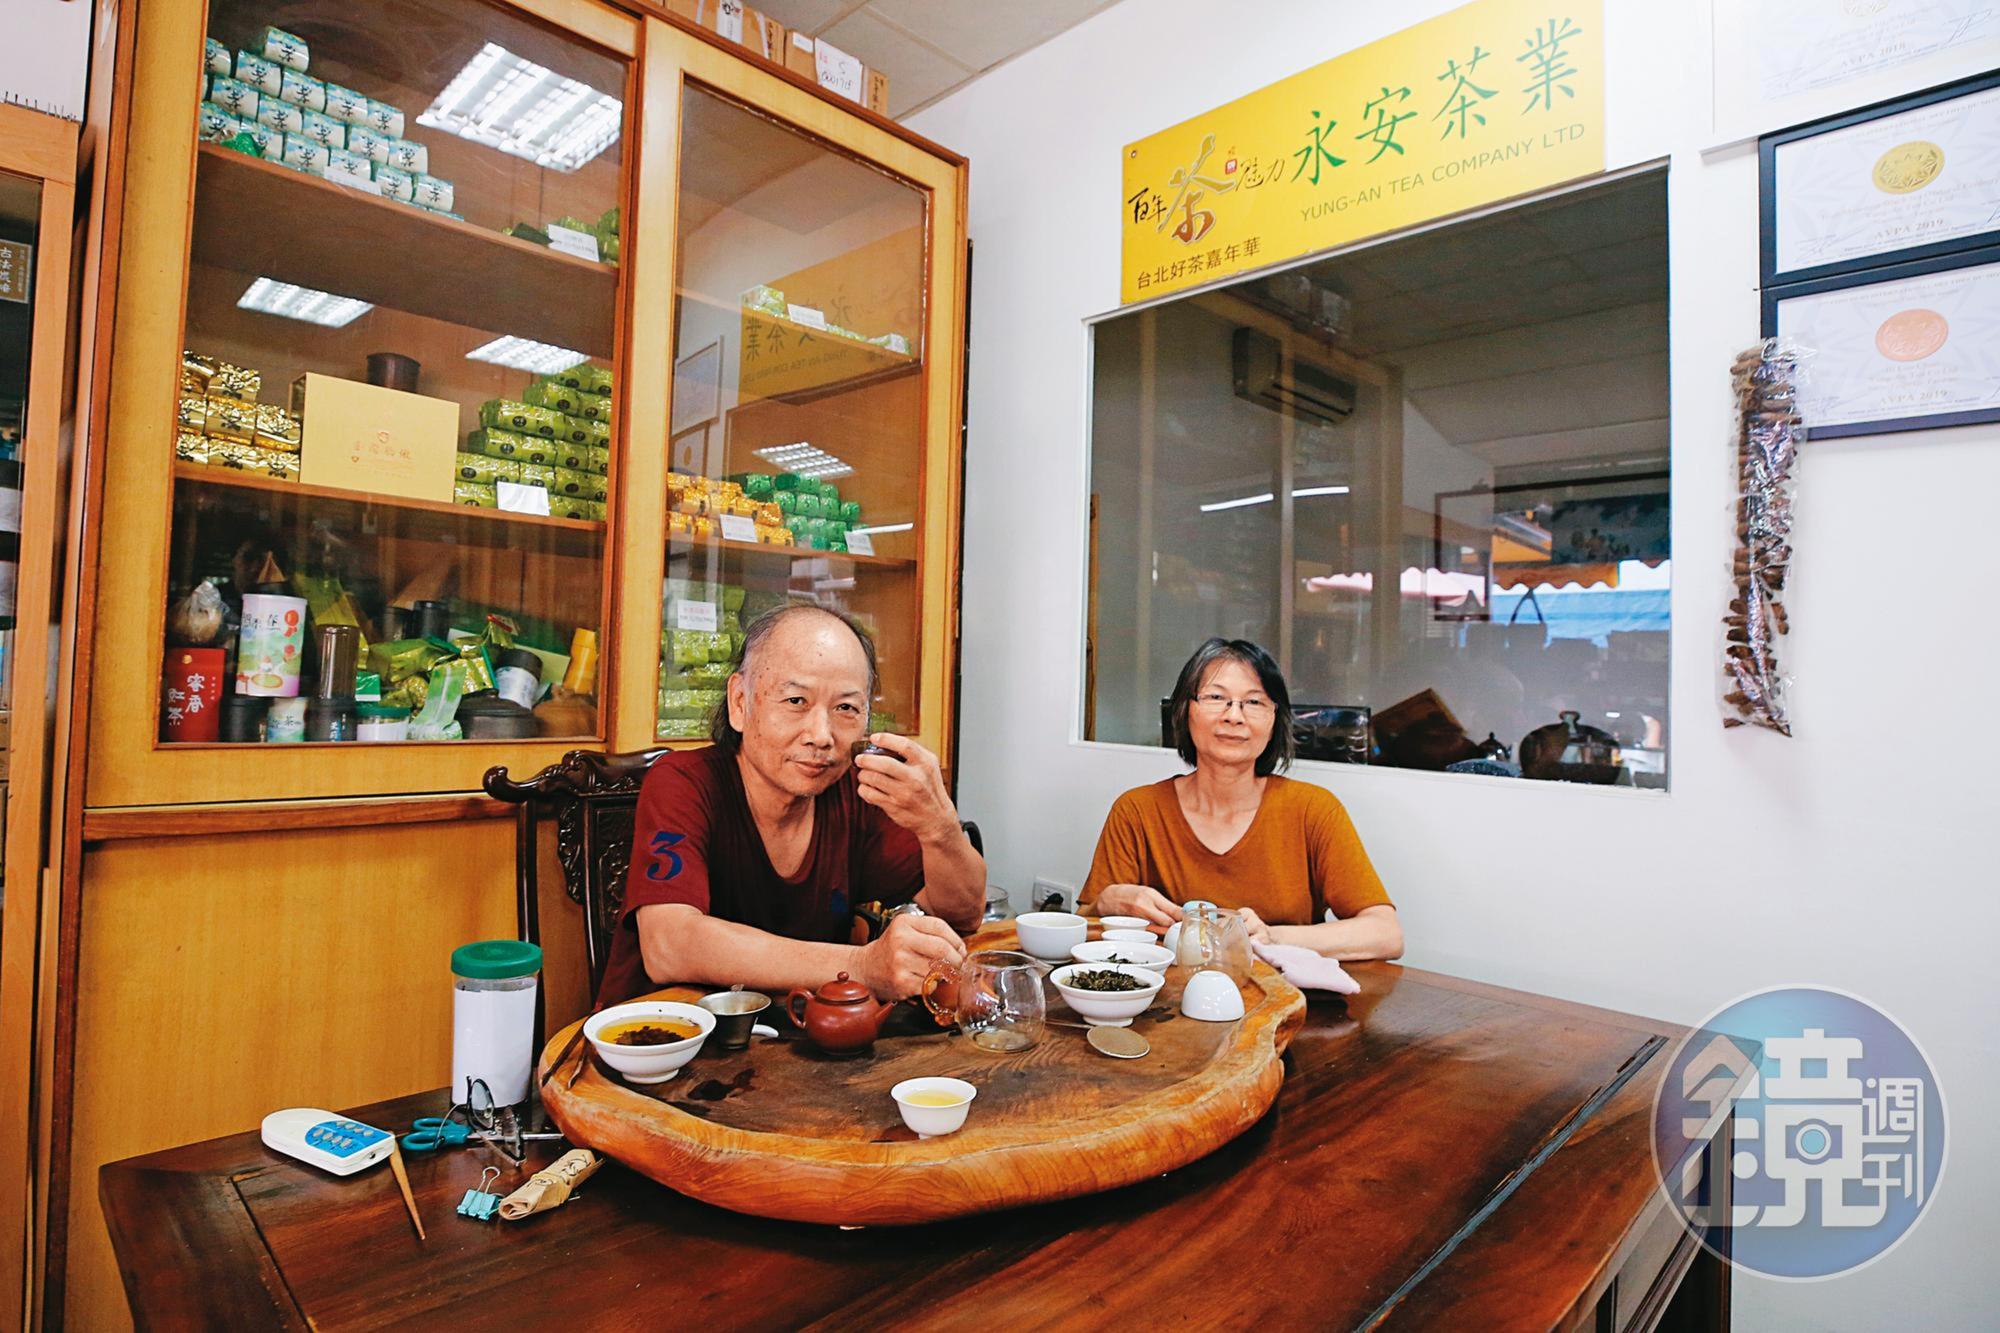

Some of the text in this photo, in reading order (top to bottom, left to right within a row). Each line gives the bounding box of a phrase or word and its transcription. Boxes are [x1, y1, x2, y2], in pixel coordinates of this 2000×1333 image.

[1291, 17, 1583, 186] 永安茶業
[1301, 123, 1585, 221] YUNG-AN TEA COMPANY LTD
[1137, 236, 1262, 290] 台北好茶嘉年華
[646, 830, 687, 882] 3
